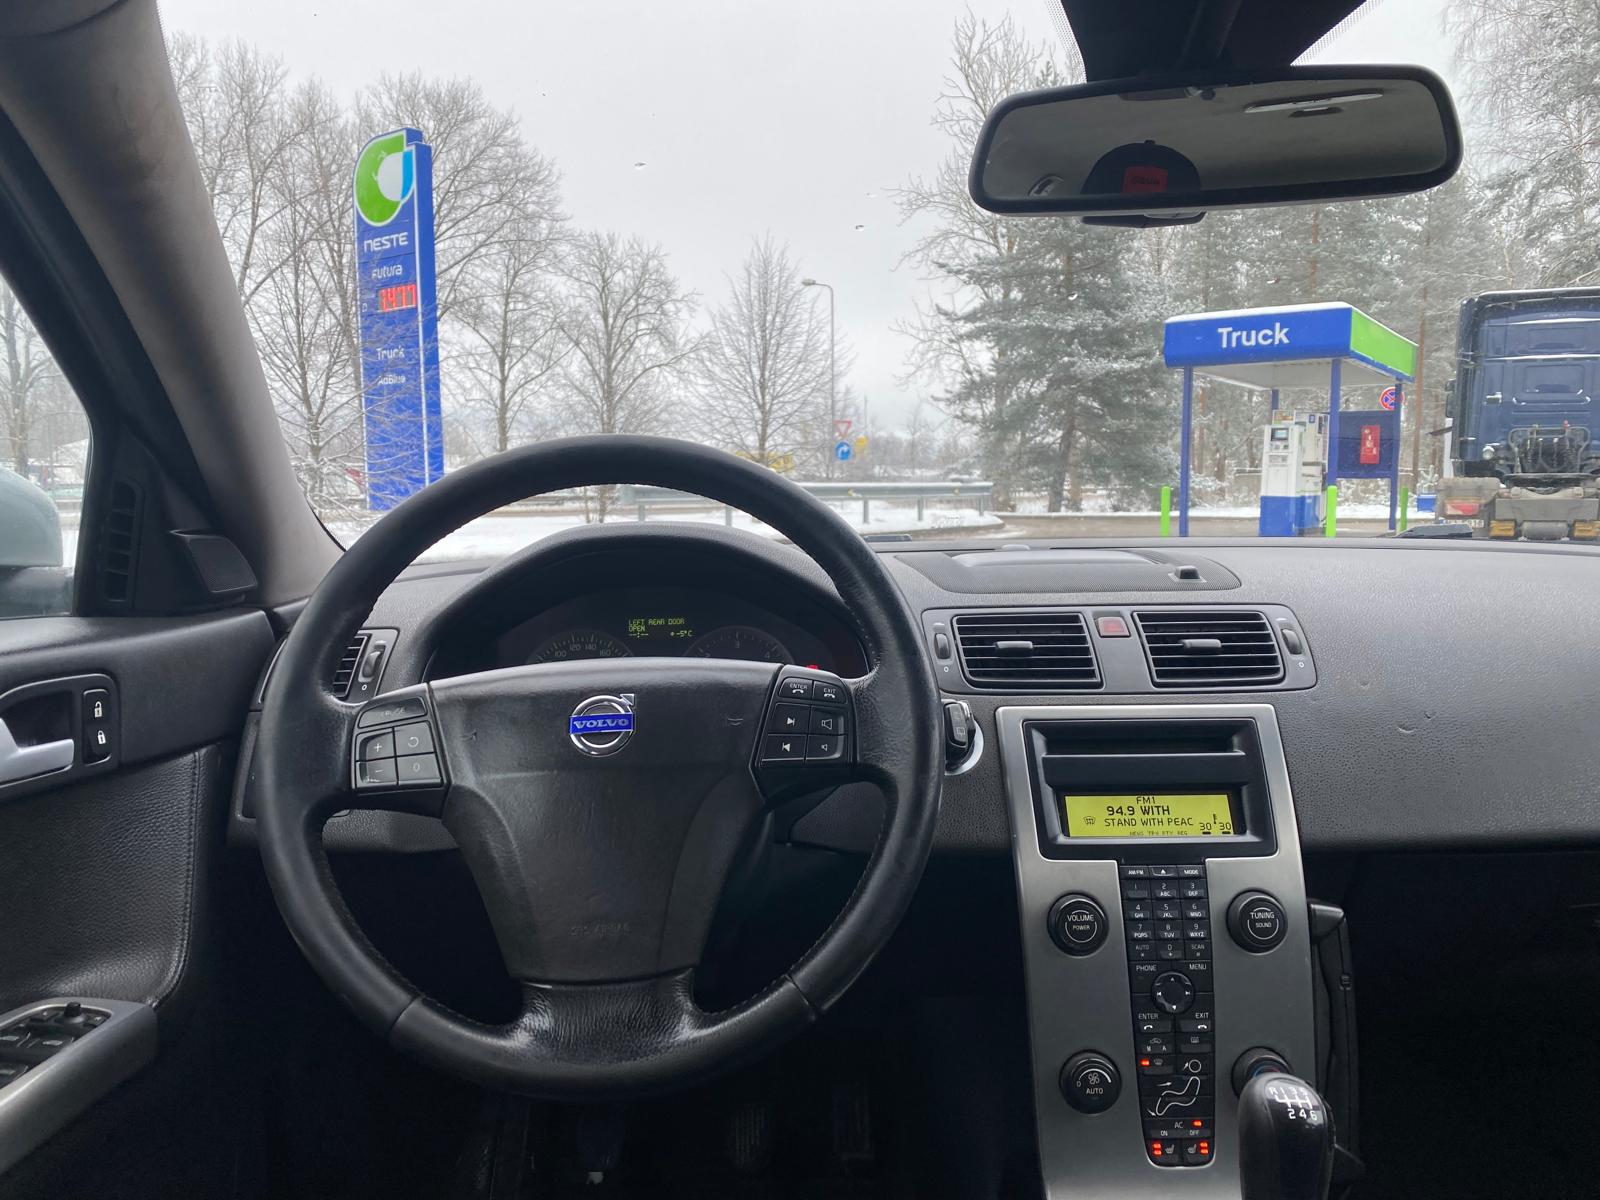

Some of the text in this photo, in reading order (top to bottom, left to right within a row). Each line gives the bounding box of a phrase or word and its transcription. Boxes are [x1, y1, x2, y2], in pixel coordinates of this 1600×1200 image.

[1217, 322, 1290, 349] Truck
[376, 345, 405, 360] Truck
[649, 618, 666, 626] REAR
[667, 617, 685, 625] DOOR
[628, 624, 646, 632] OPEN
[573, 718, 629, 730] VOLVO
[1136, 796, 1156, 805] FM1
[1106, 805, 1171, 816] 94.9 WITH
[1104, 817, 1194, 827] STAND WITH PEAC
[1199, 822, 1212, 831] 30
[1219, 822, 1232, 831] 30
[1163, 903, 1169, 911] 5
[1066, 914, 1095, 922] VOLUME
[1250, 911, 1275, 919] TUNING
[1136, 964, 1157, 972] PHONE
[1086, 1087, 1104, 1095] AUTO
[1287, 1108, 1318, 1121] 2 4 6
[1174, 1121, 1184, 1129] AC
